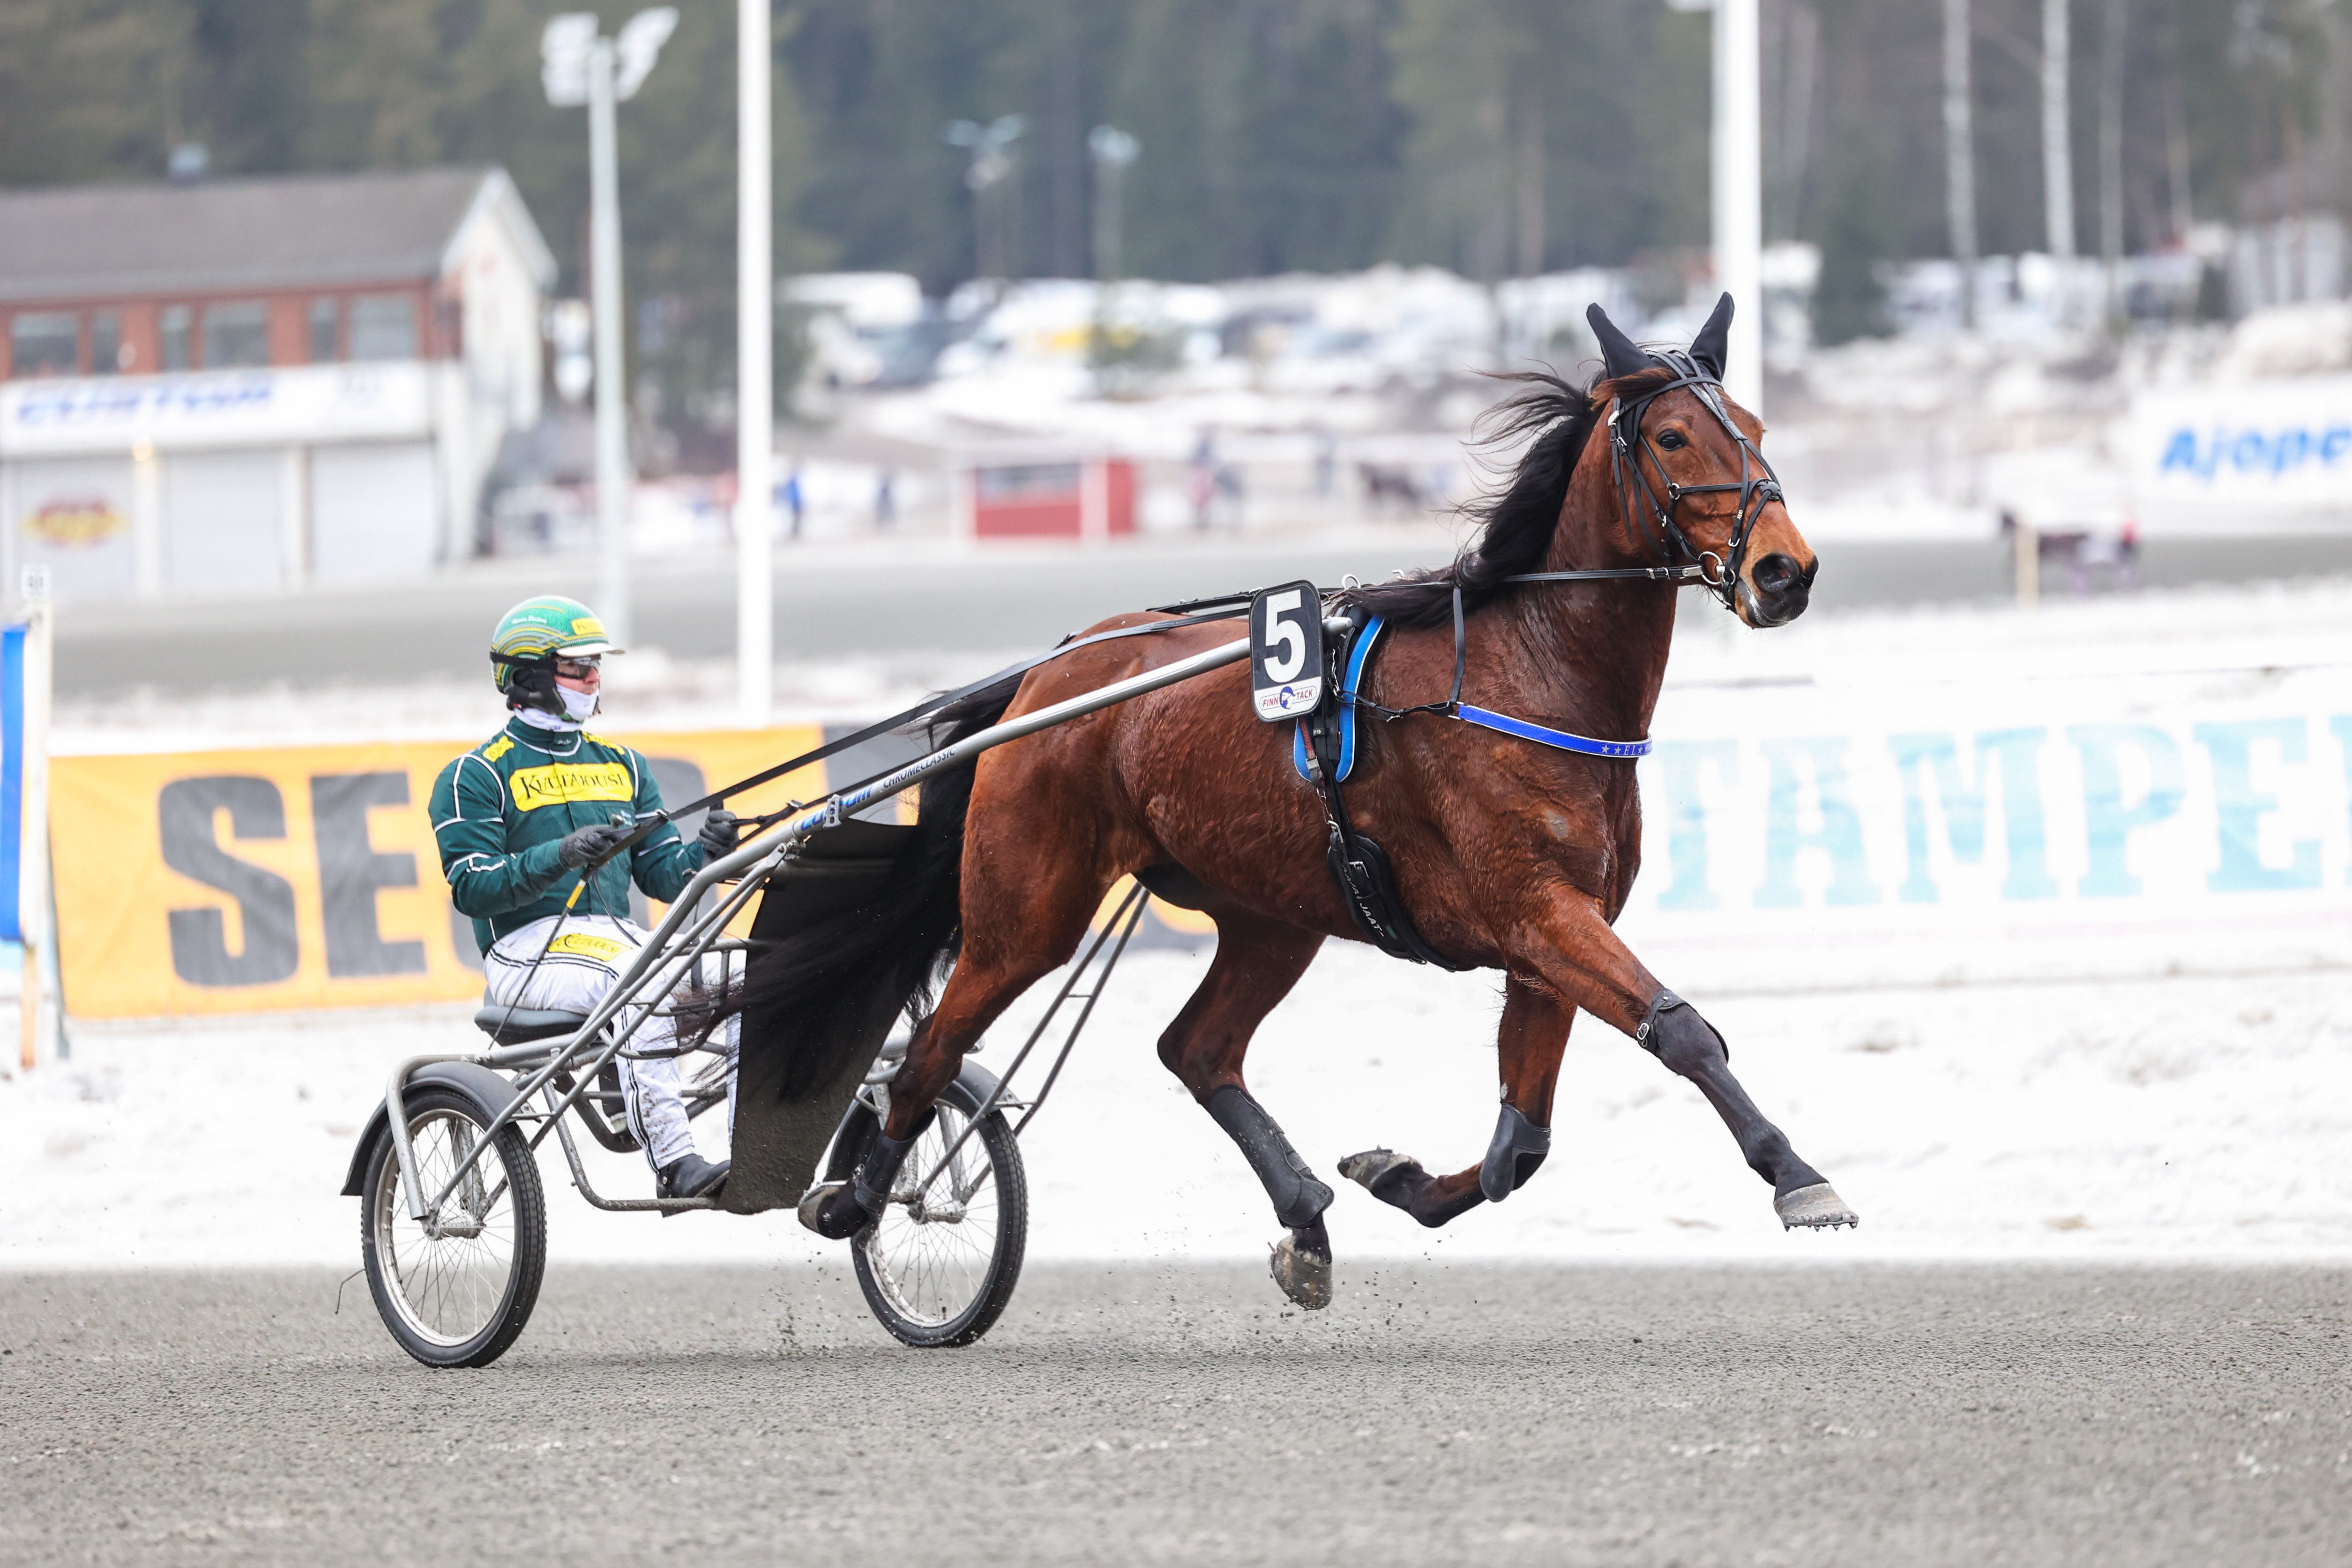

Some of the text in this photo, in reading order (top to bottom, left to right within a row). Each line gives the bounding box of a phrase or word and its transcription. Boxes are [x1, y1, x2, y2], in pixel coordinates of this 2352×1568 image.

[1264, 589, 1306, 683] 5
[1262, 689, 1313, 707] FINN TACK
[883, 746, 956, 789] CHROMECLASSIC
[1647, 713, 2352, 912] TAMPE
